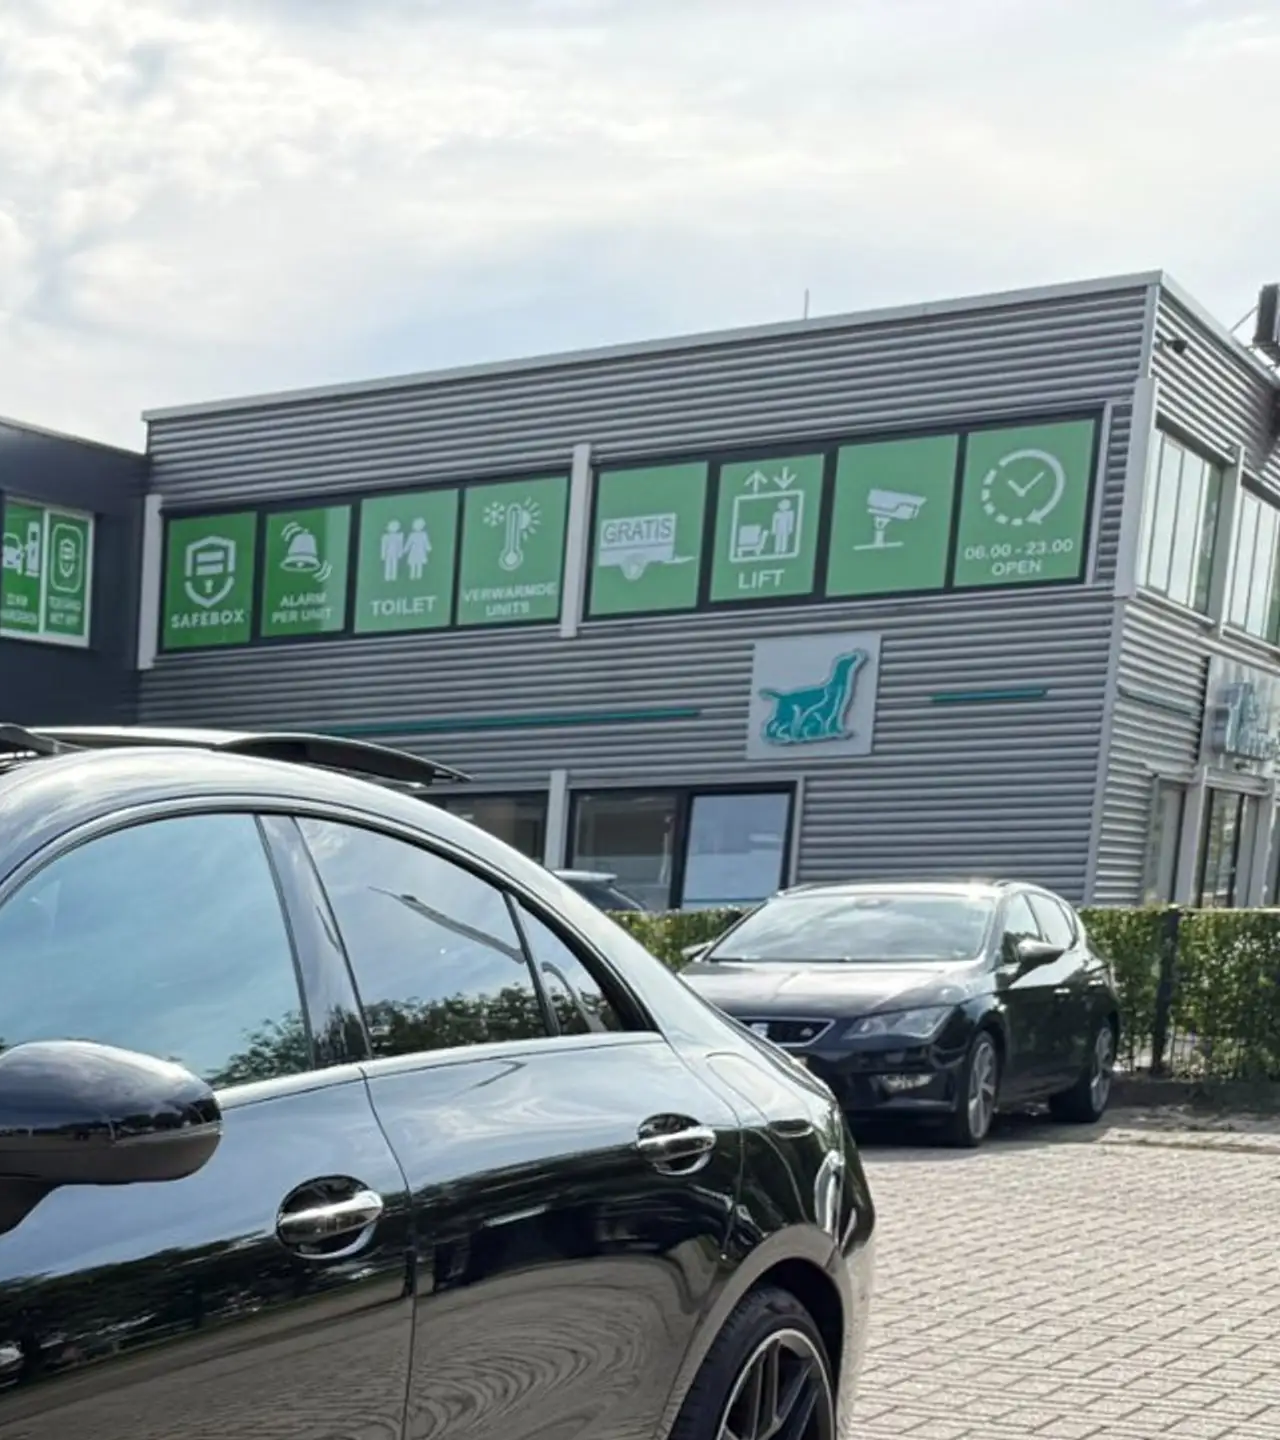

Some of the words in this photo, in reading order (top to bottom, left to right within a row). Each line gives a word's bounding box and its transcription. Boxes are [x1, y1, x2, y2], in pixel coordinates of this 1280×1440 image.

[603, 518, 673, 543] GRATIS
[991, 560, 1042, 576] OPEN
[737, 569, 786, 589] LIFT
[279, 592, 328, 608] ALARM
[462, 582, 557, 602] VERWARMDE
[271, 610, 299, 624] PER
[300, 607, 333, 622] UNIT
[369, 595, 438, 617] TOILET
[485, 601, 531, 617] UNITS
[171, 608, 246, 629] SAFEBOX
